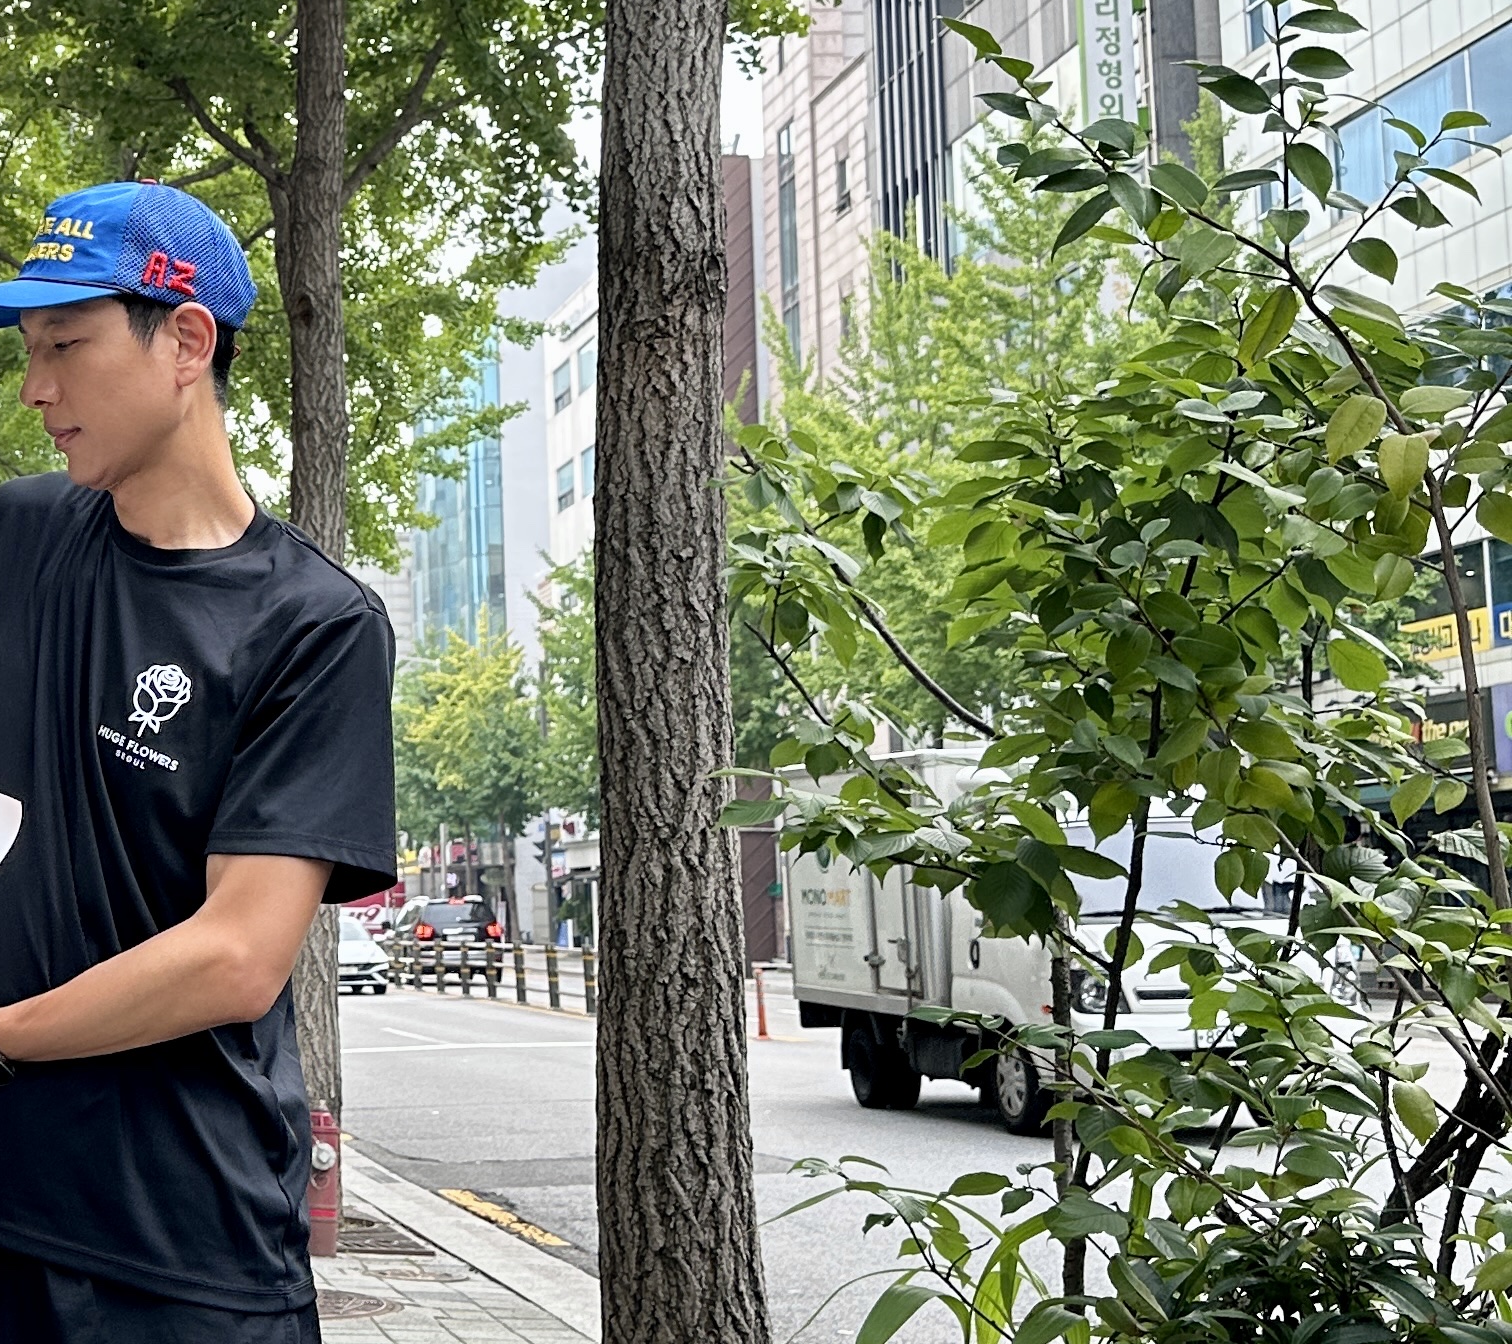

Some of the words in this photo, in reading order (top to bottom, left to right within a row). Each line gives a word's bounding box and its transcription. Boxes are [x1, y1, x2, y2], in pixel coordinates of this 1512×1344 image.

[54, 217, 94, 240] ALL
[142, 251, 197, 296] AZ
[97, 724, 126, 747] HUGE
[125, 739, 179, 771] FLOWERS
[115, 749, 145, 770] SEOUL
